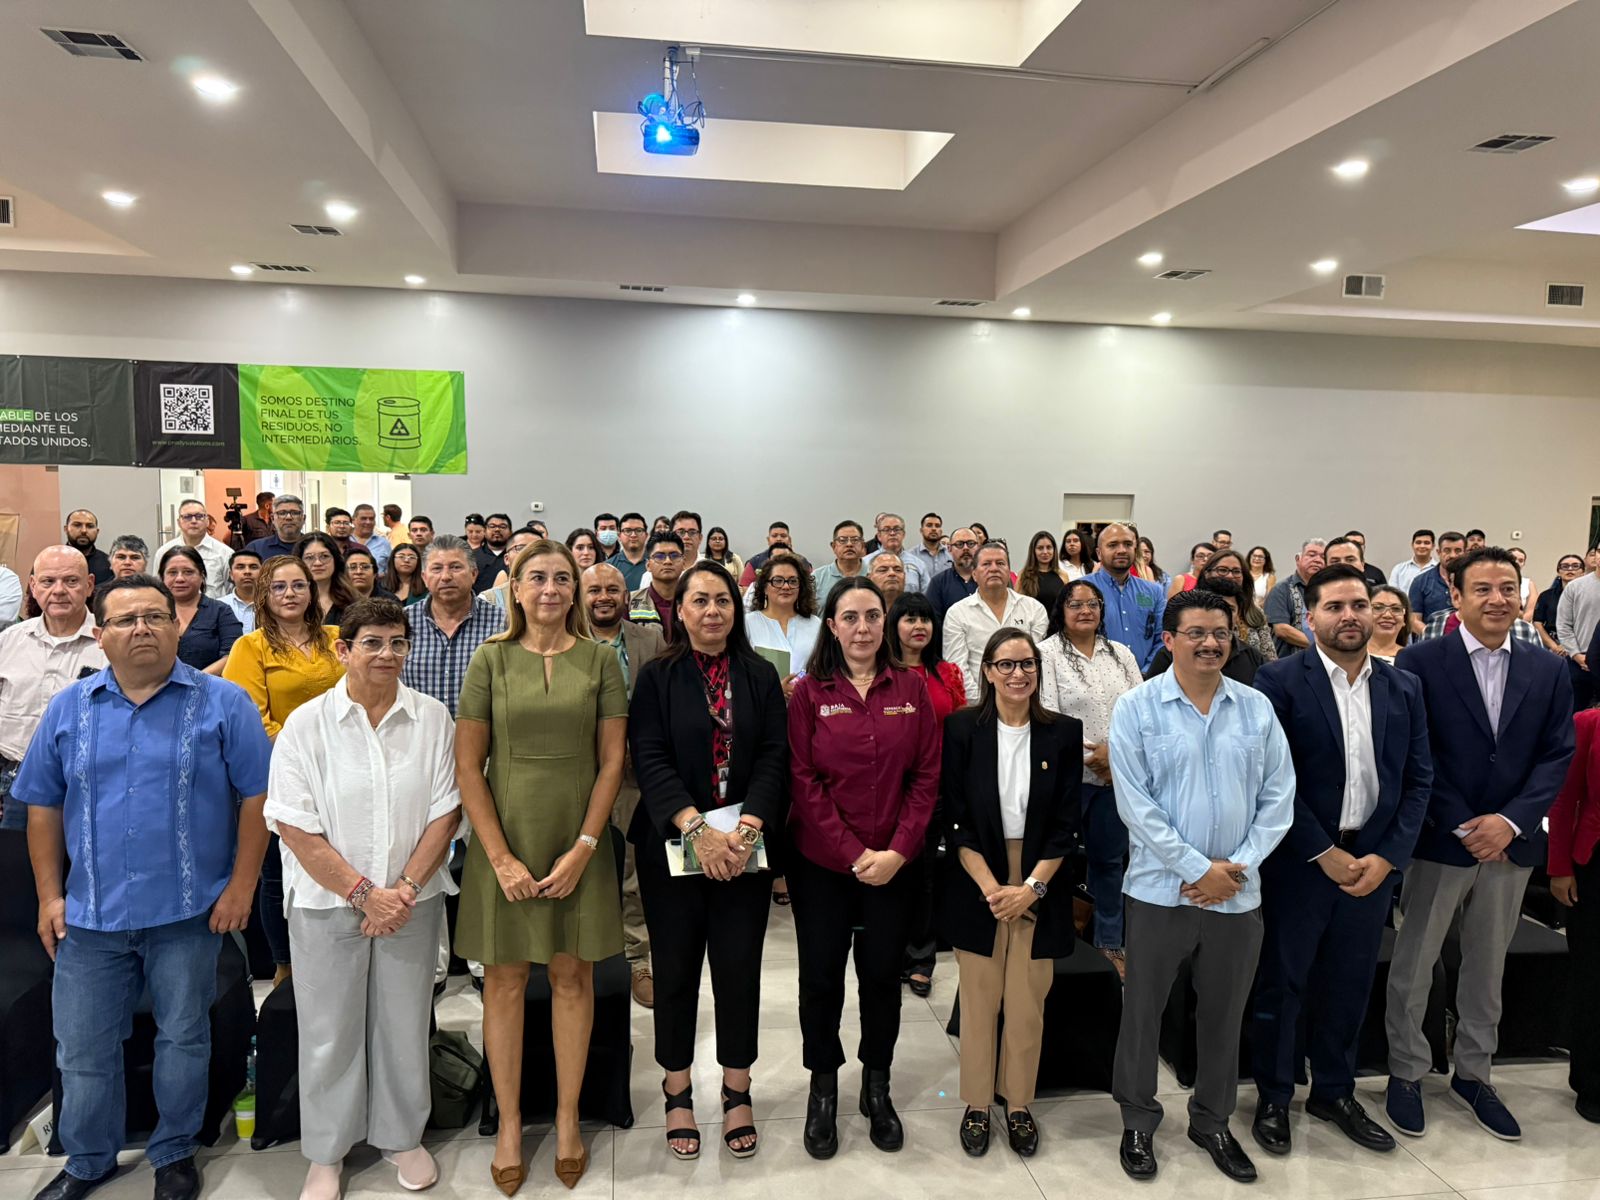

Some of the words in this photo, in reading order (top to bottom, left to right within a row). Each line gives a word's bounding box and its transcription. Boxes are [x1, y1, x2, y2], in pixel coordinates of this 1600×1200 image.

[260, 395, 302, 405] SOMOS
[306, 397, 355, 407] DESTINO
[35, 412, 51, 421] DE
[55, 412, 78, 422] LOS
[261, 409, 295, 418] FINAL
[298, 409, 315, 418] DE
[318, 410, 339, 419] TUS
[60, 425, 74, 434] EL
[261, 421, 322, 433] RESIDUOS,
[325, 424, 342, 432] NO
[41, 437, 91, 447] UNIDOS.
[261, 434, 361, 445] INTERMEDIARIOS.
